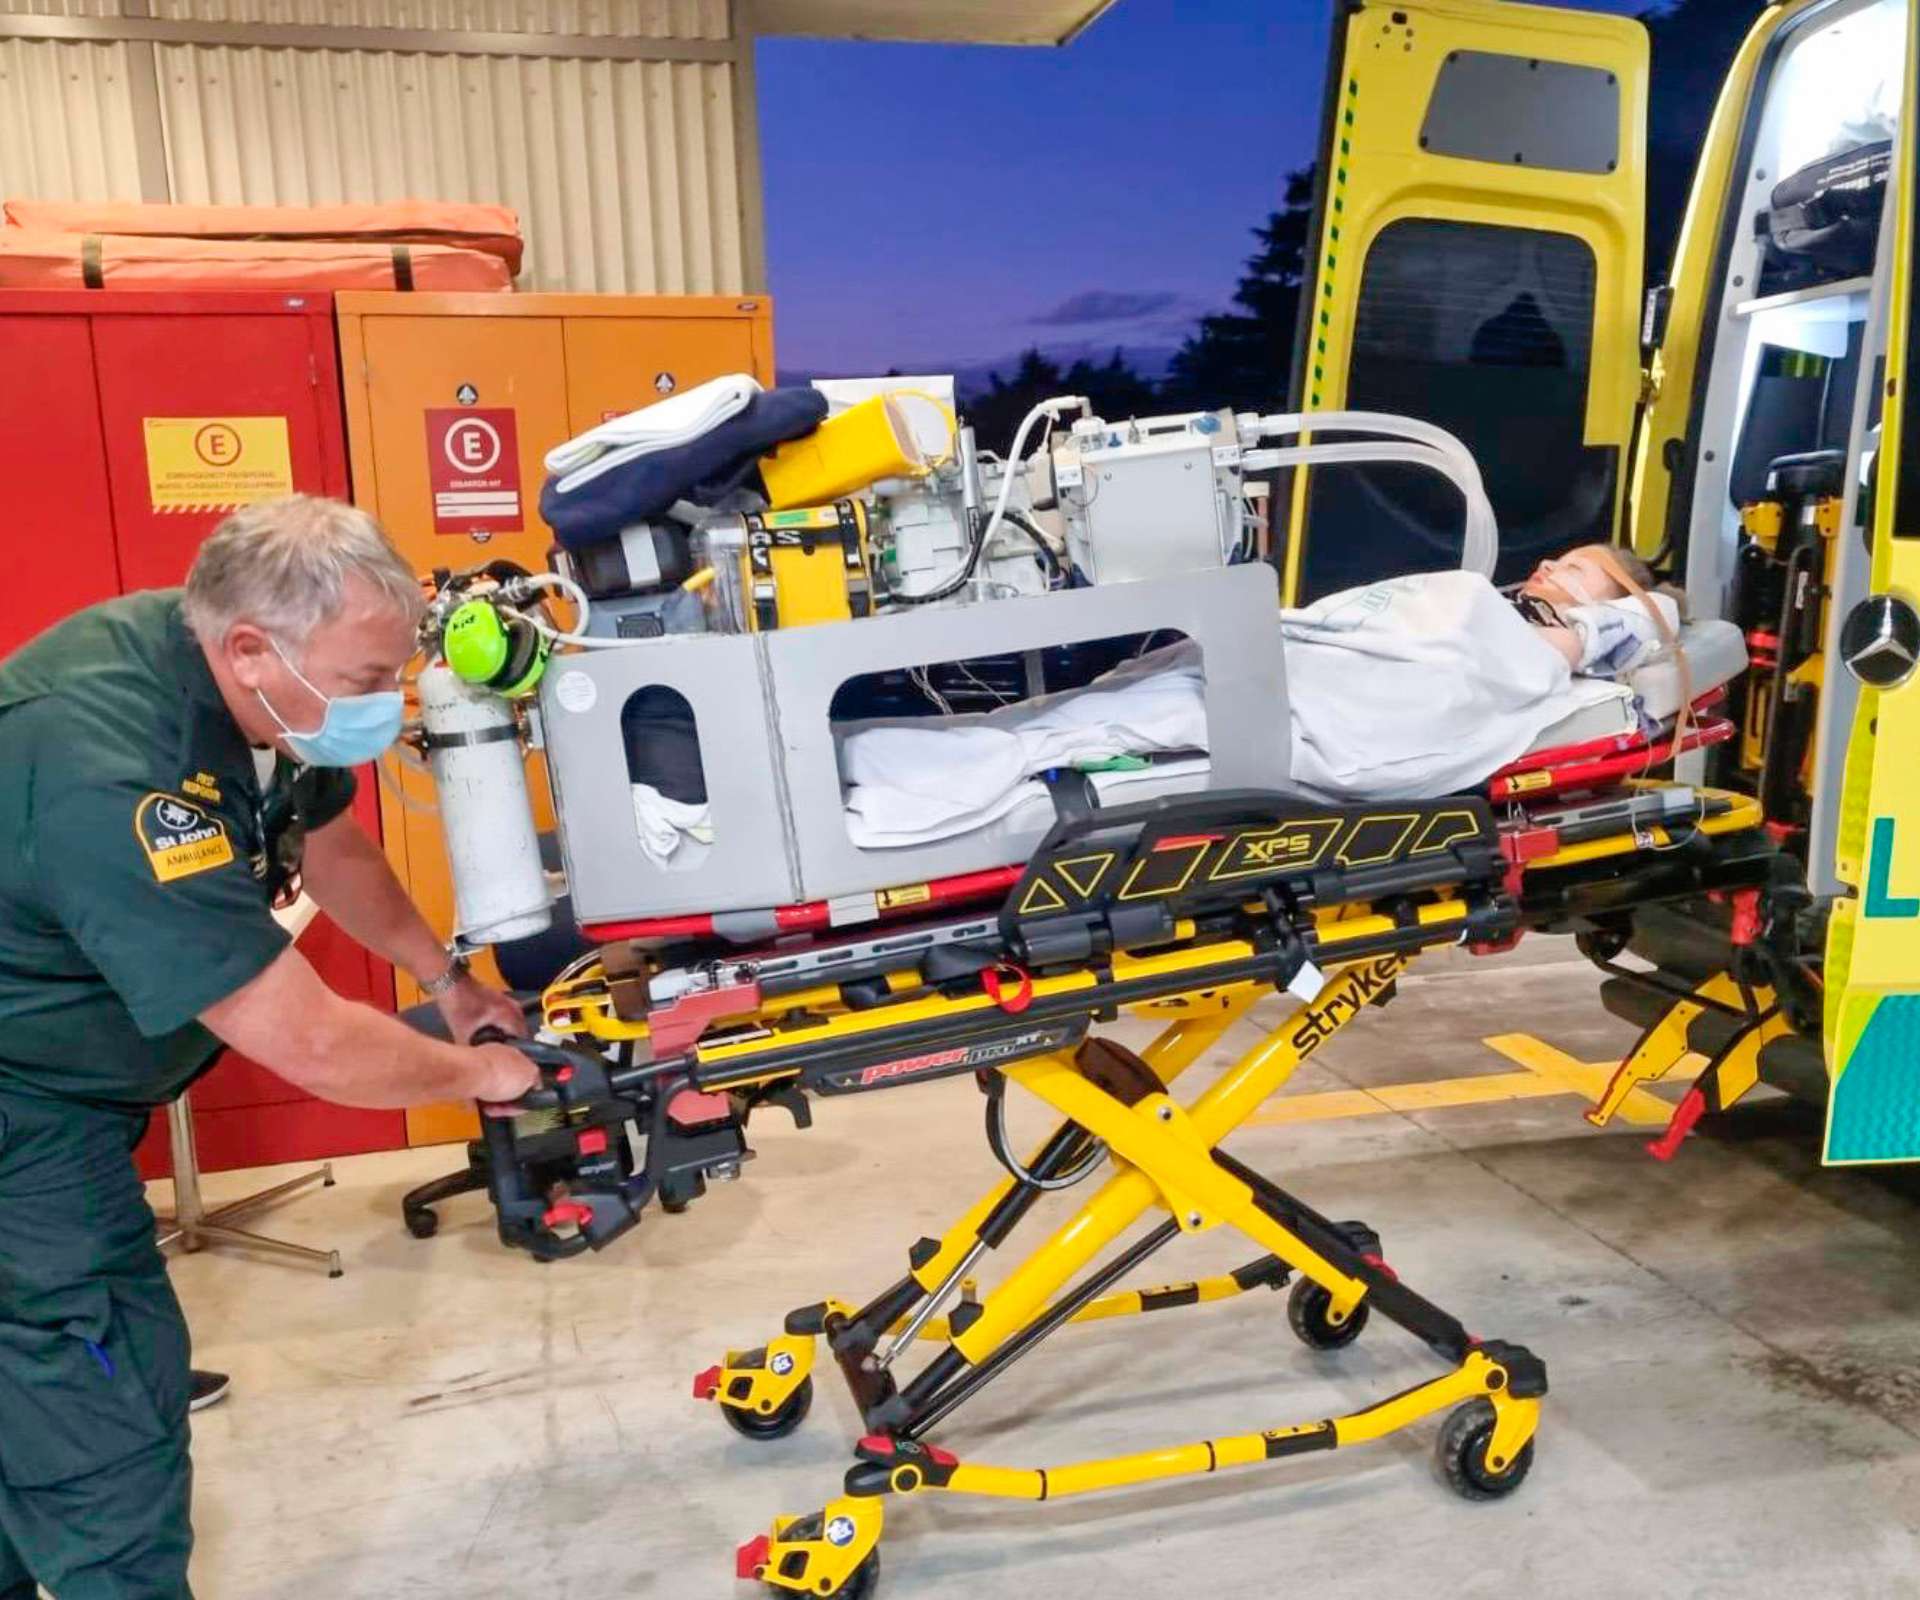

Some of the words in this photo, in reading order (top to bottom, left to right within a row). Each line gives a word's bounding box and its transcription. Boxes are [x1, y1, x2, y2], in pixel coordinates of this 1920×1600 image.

[209, 433, 226, 456] E
[463, 431, 483, 460] E
[154, 835, 177, 850] St
[179, 826, 218, 845] John
[1243, 833, 1311, 863] XPS
[166, 844, 224, 867] AMBULANCE
[1291, 951, 1408, 1061] stryke
